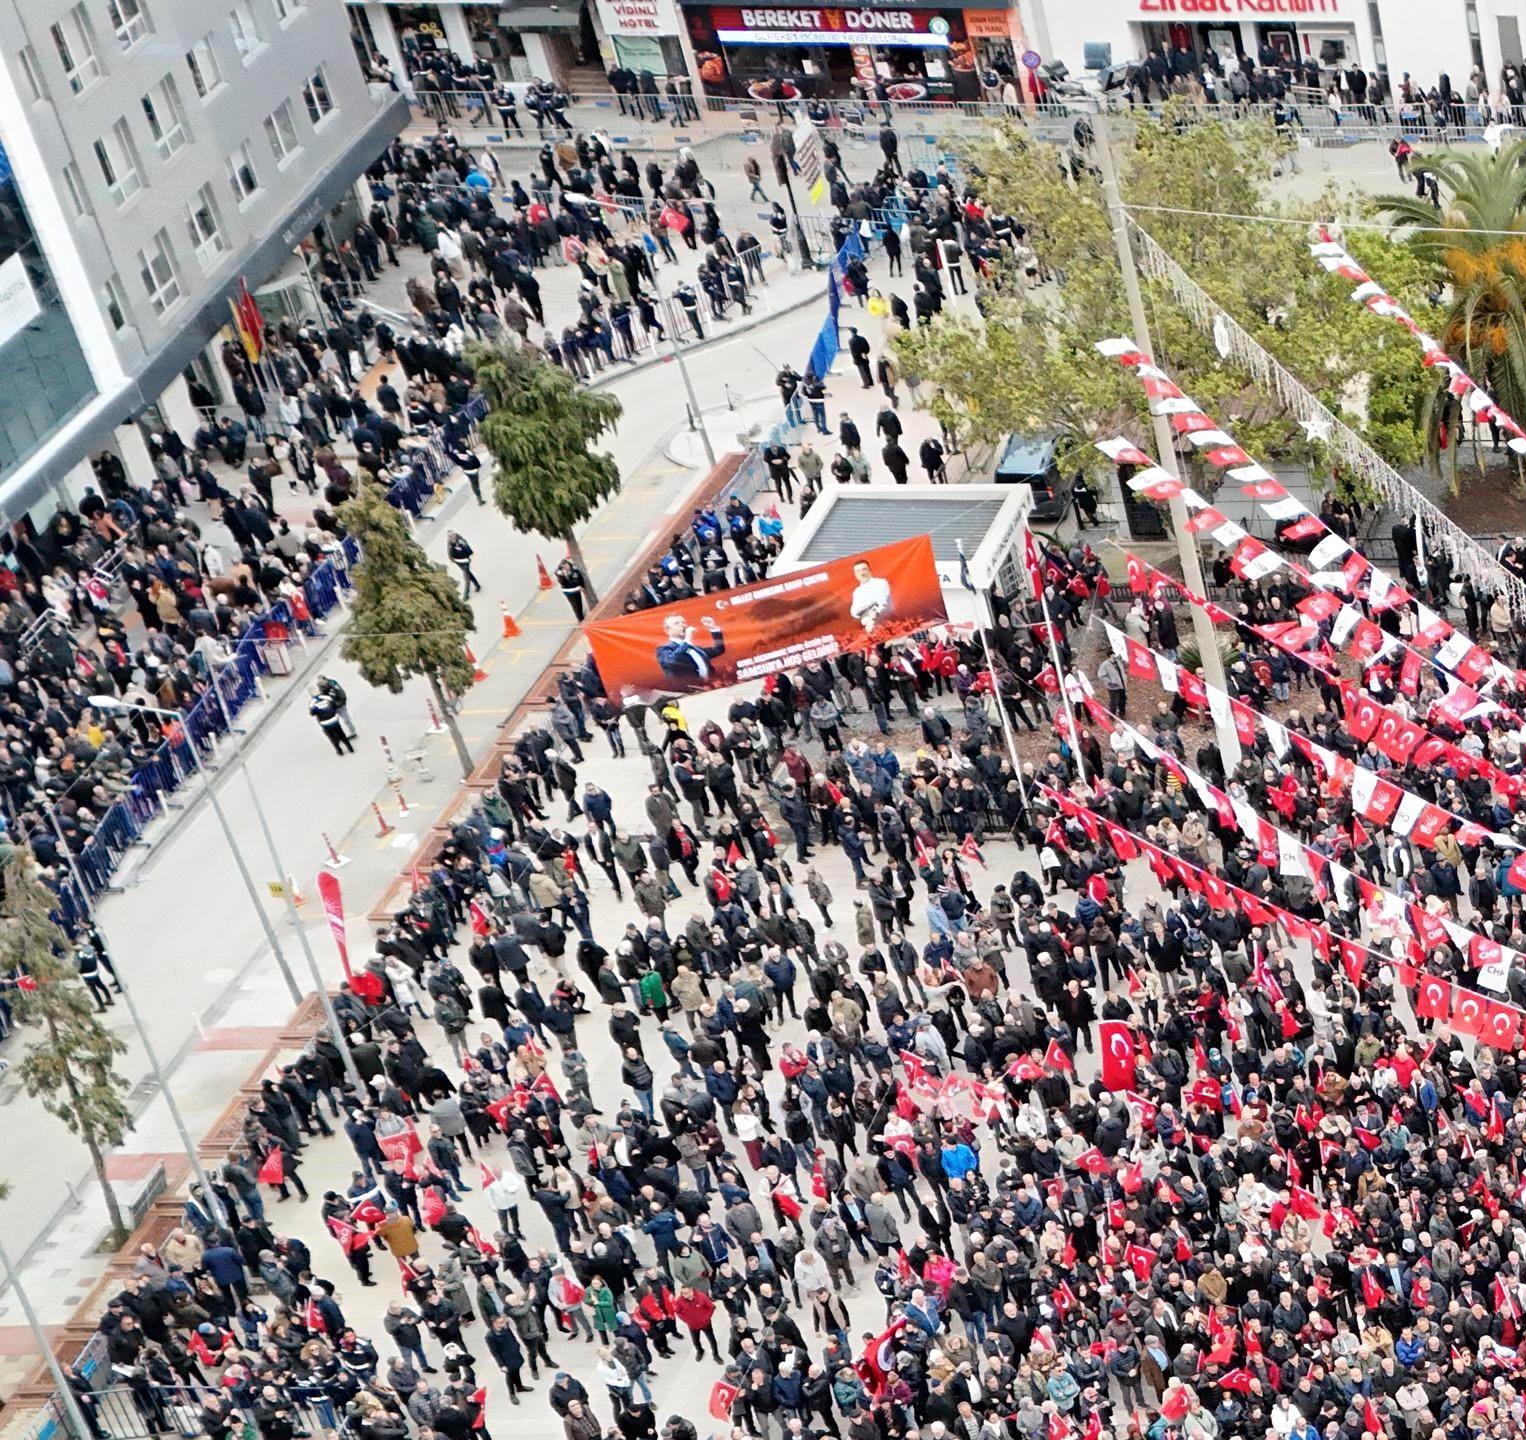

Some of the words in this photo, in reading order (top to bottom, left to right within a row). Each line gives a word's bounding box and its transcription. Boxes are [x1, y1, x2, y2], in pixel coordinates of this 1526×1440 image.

[619, 18, 660, 29] HOTEL
[741, 9, 822, 28] BEREKET
[845, 6, 914, 29] DÖNER
